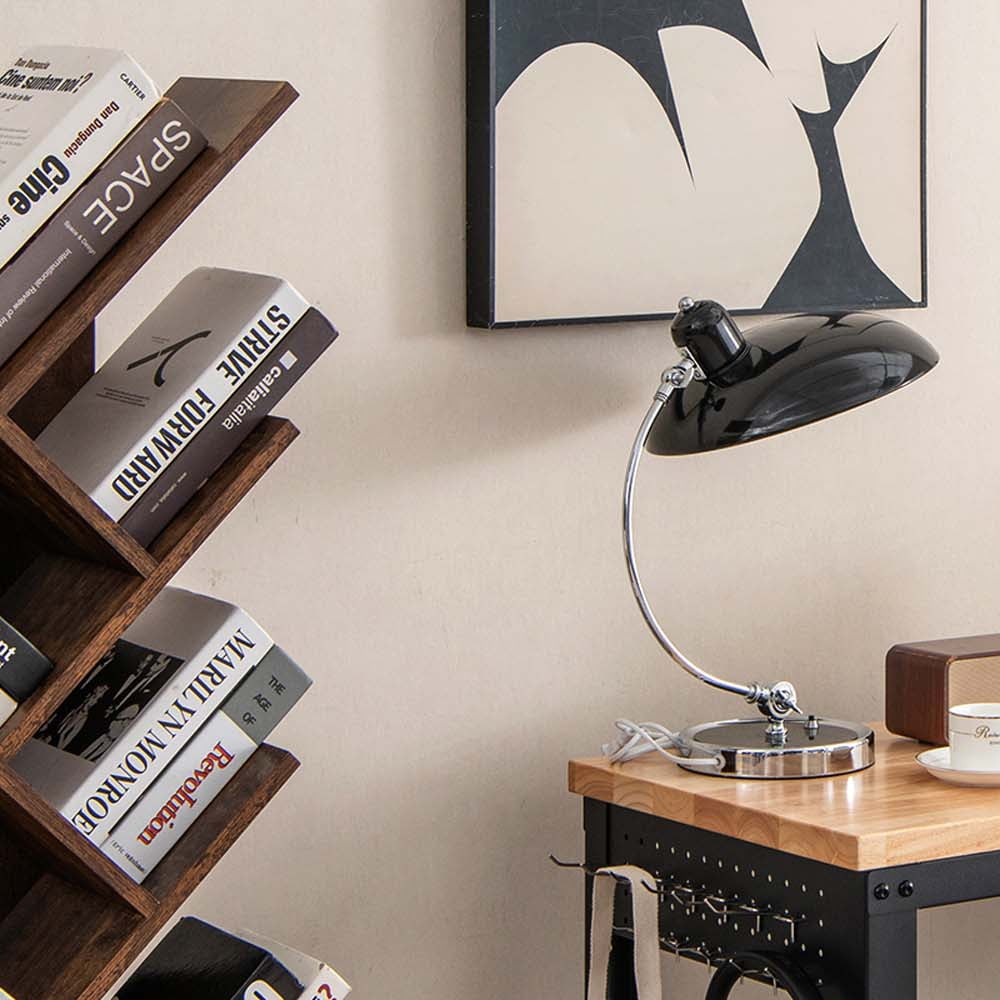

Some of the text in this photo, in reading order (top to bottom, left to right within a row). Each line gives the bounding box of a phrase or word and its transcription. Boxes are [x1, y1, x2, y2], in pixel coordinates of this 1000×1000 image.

[21, 74, 62, 91] suntem
[57, 72, 93, 94] noi?
[119, 72, 146, 101] CARTIER
[63, 100, 120, 158] Dan Dungaciu
[7, 154, 71, 215] Cine
[82, 119, 192, 235] SPACE
[0, 213, 11, 231] su
[36, 248, 73, 289] International
[6, 309, 15, 320] of
[12, 285, 38, 310] Review
[215, 304, 292, 386] STRIVE
[221, 365, 283, 430] caliaitalia
[111, 387, 217, 501] FORWARD
[252, 693, 273, 714] AGE
[267, 675, 287, 696] THE
[71, 628, 256, 836] MARILYN MONROE
[242, 712, 258, 726] OF
[136, 740, 236, 846] Revolution
